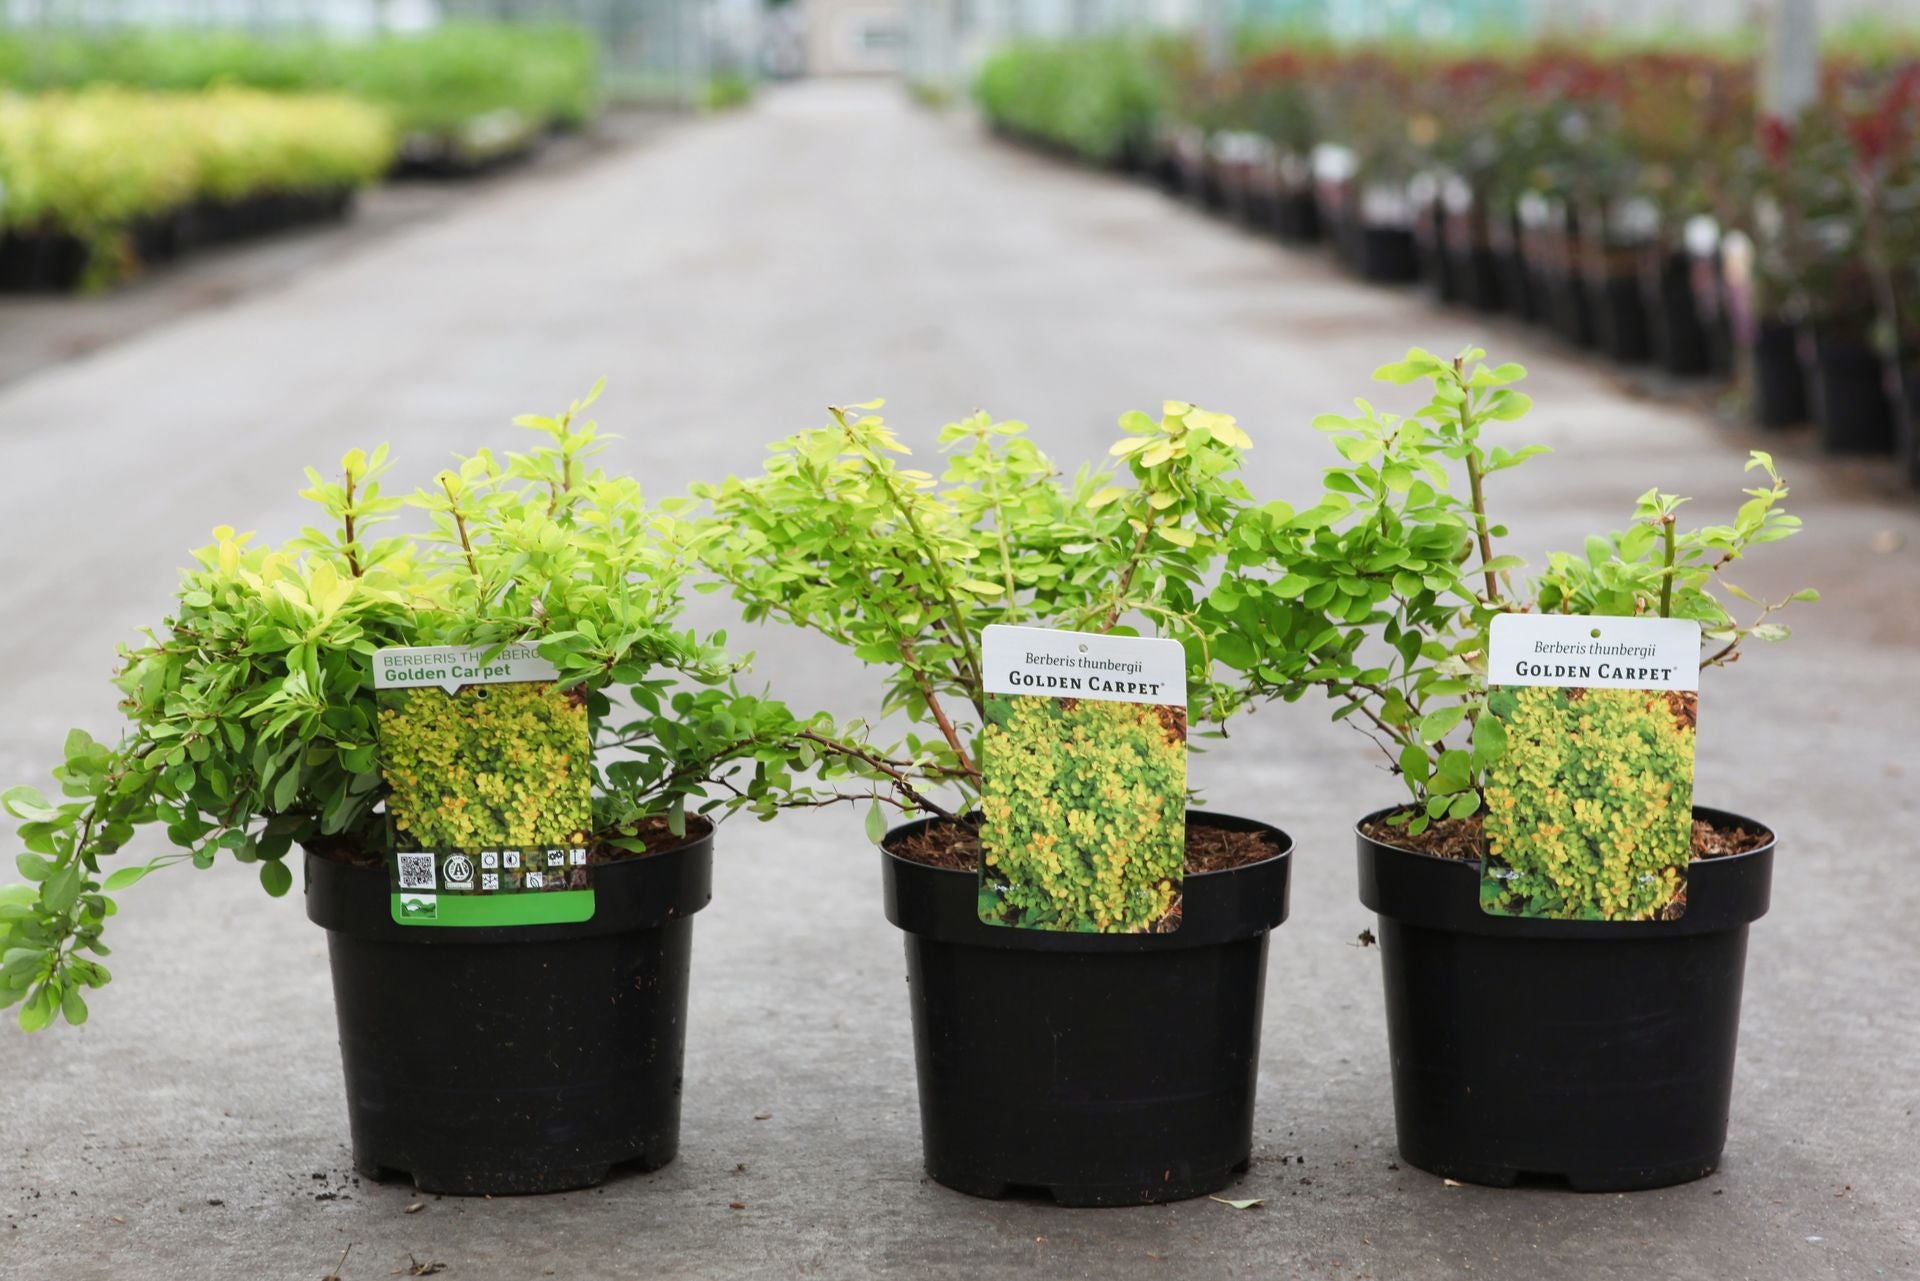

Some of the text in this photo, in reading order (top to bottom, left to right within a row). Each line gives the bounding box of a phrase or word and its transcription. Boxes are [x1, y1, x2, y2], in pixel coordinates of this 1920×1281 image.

[1534, 640, 1656, 659] Berberis thunbergii
[383, 652, 456, 667] BERBERIS
[1025, 652, 1143, 675] Berberis thunbergii
[385, 663, 511, 682] Golden Carpet
[1516, 661, 1591, 678] GOLDEN
[1009, 670, 1082, 690] GOLDEN
